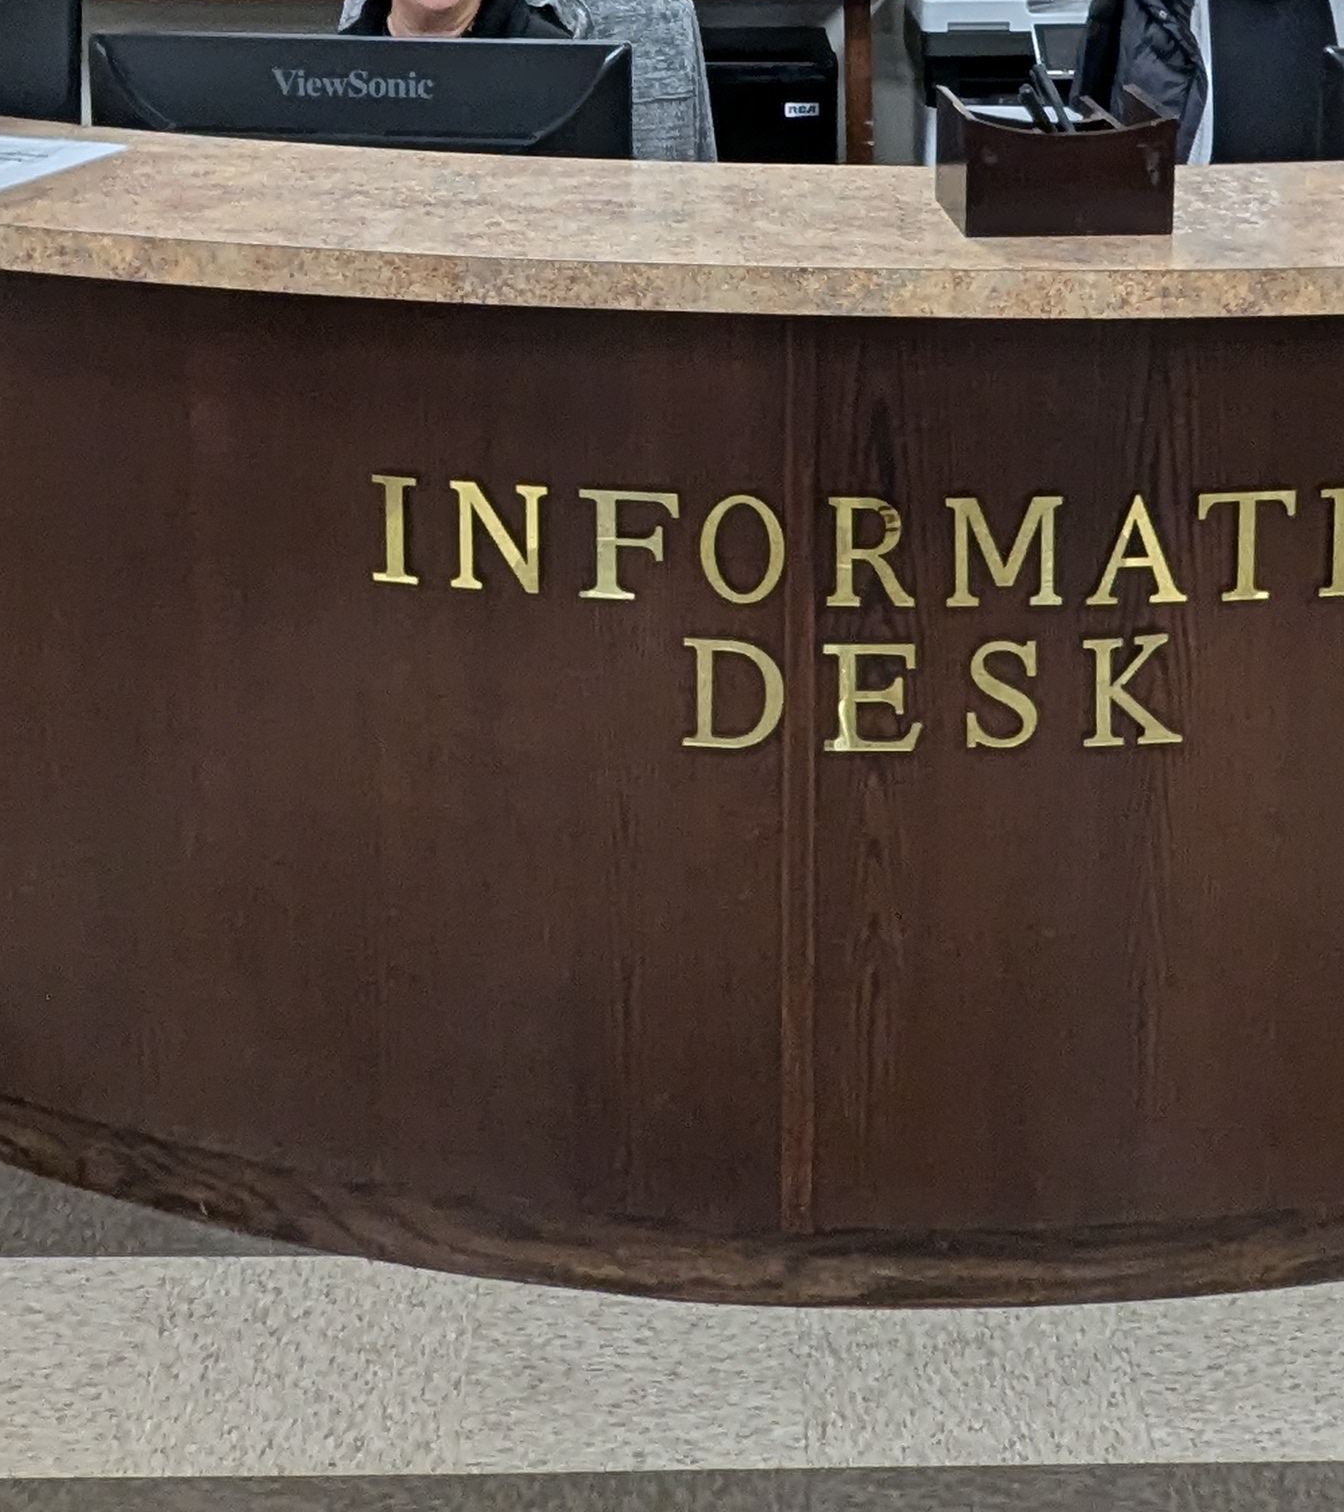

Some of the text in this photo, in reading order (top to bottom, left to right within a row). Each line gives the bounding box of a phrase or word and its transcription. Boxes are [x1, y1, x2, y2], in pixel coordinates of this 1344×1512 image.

[271, 65, 434, 100] ViewSonic
[787, 104, 817, 115] RCA
[682, 633, 1183, 752] DESK
